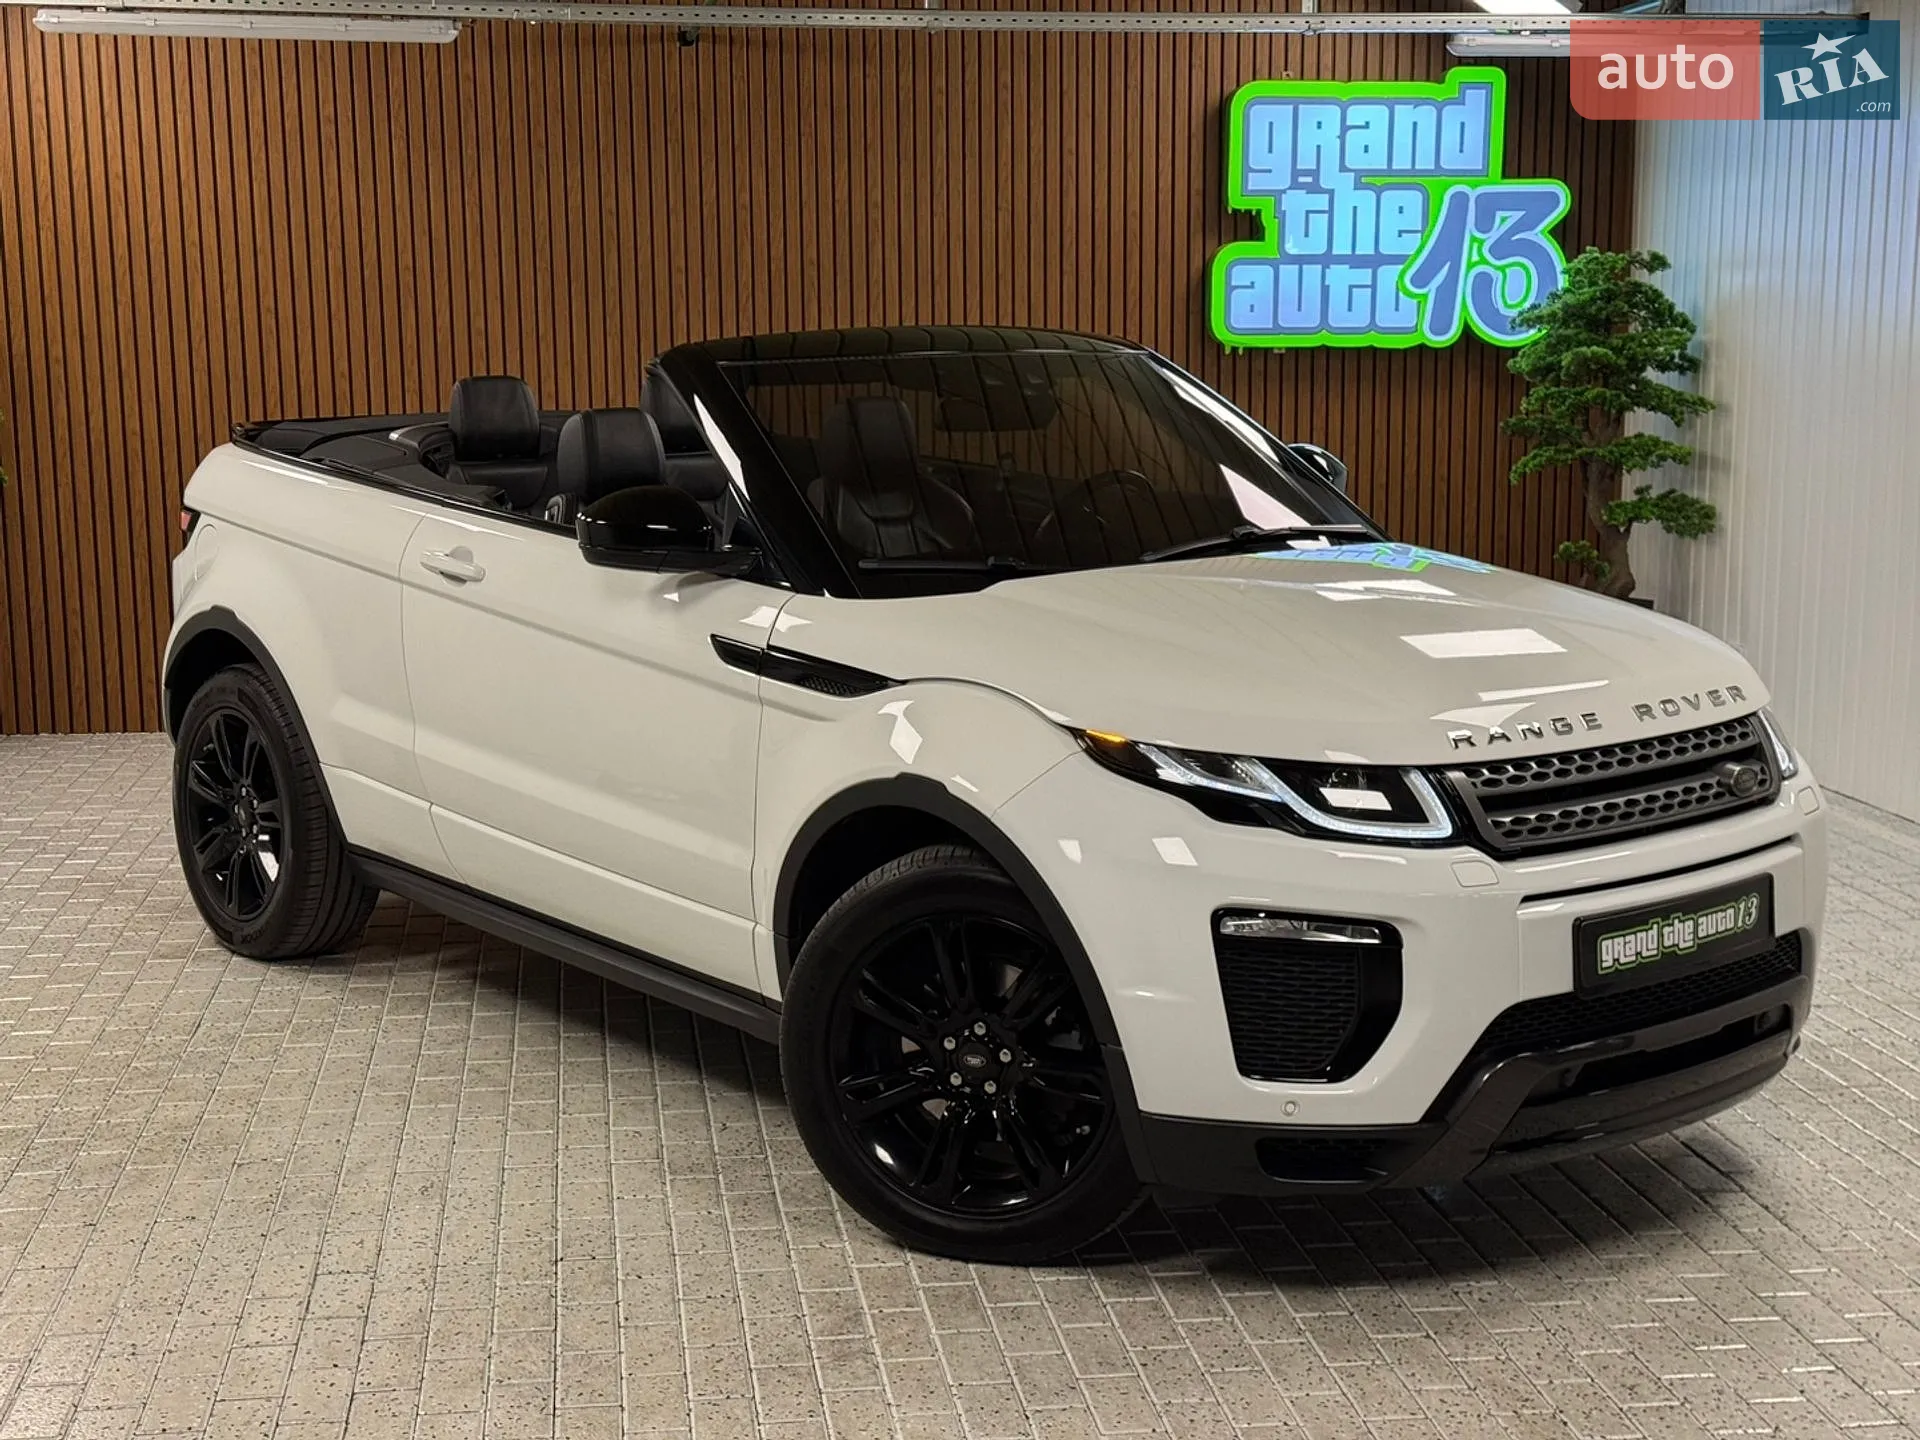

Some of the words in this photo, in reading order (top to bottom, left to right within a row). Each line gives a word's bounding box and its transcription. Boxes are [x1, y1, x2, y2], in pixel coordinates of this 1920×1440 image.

[1281, 174, 1423, 255] the
[1446, 711, 1603, 751] RANGE
[1633, 685, 1747, 723] ROVER
[1662, 917, 1695, 950] the
